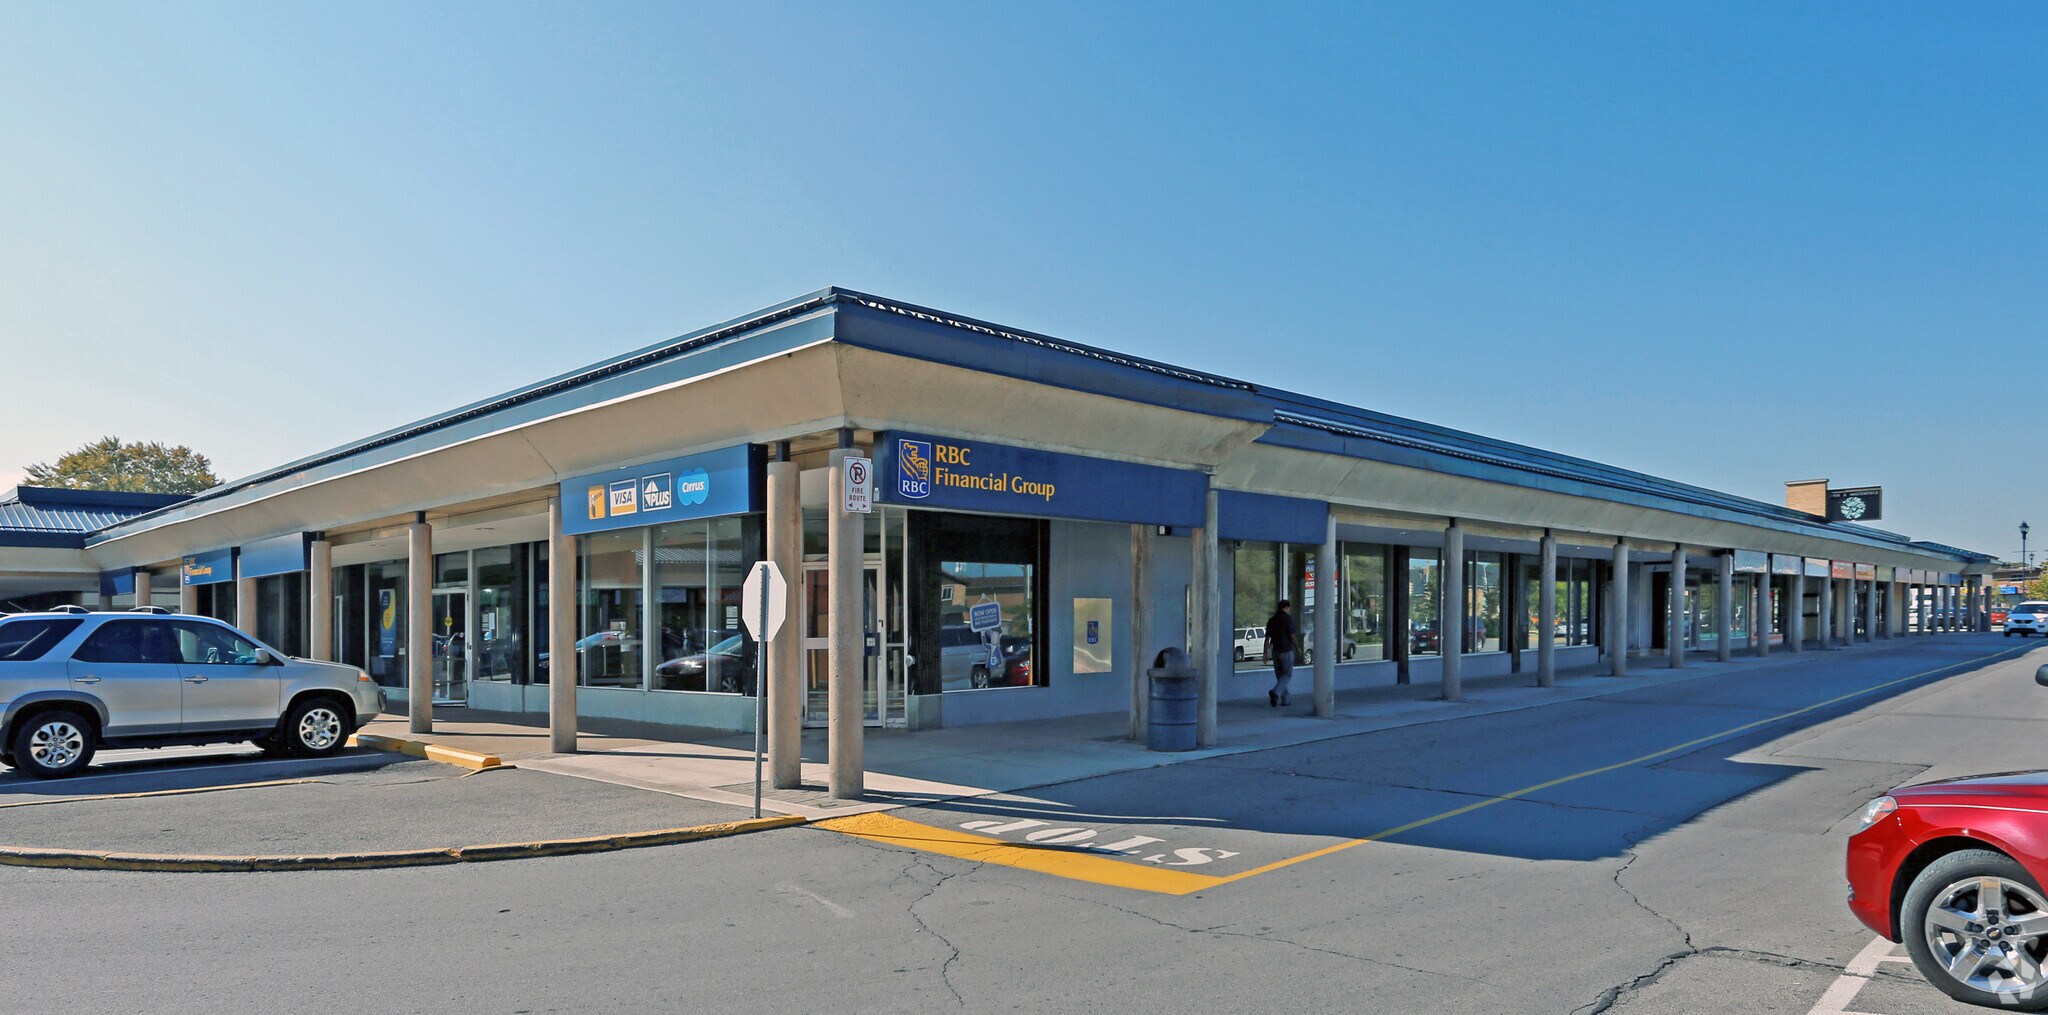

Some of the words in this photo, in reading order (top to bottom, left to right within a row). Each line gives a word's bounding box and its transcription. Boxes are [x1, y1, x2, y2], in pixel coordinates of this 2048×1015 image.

[935, 444, 971, 466] RBC
[682, 481, 704, 493] Cirrus
[851, 487, 864, 495] FIRE
[902, 480, 927, 494] RBC
[935, 467, 1007, 492] Financial
[1011, 476, 1056, 502] Group
[614, 491, 632, 505] VISA
[651, 490, 670, 506] PLUS
[960, 818, 1241, 866] STOP
